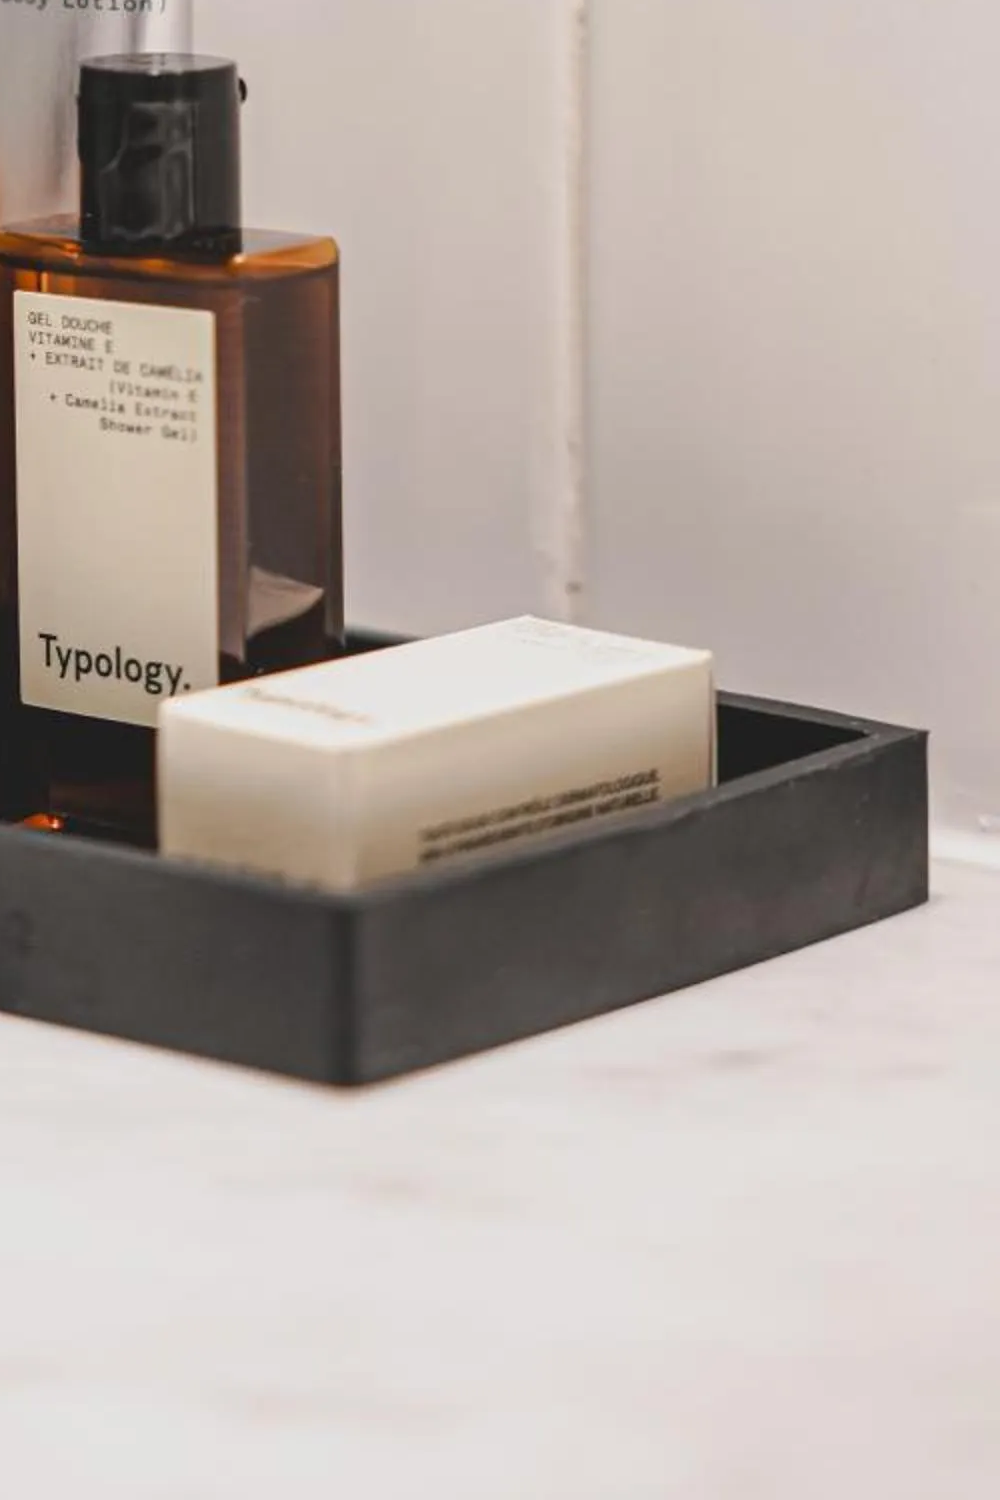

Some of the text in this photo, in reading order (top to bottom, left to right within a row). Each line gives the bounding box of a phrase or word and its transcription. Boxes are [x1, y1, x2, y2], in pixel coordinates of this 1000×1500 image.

[27, 311, 114, 335] GEL DOUCHE
[28, 331, 114, 353] VITAMINE E
[45, 352, 105, 371] EXTRAIT
[113, 360, 131, 376] DE
[65, 393, 126, 414] Camelia
[188, 390, 198, 403] E
[99, 417, 153, 435] Shower
[38, 633, 191, 695] Typology.
